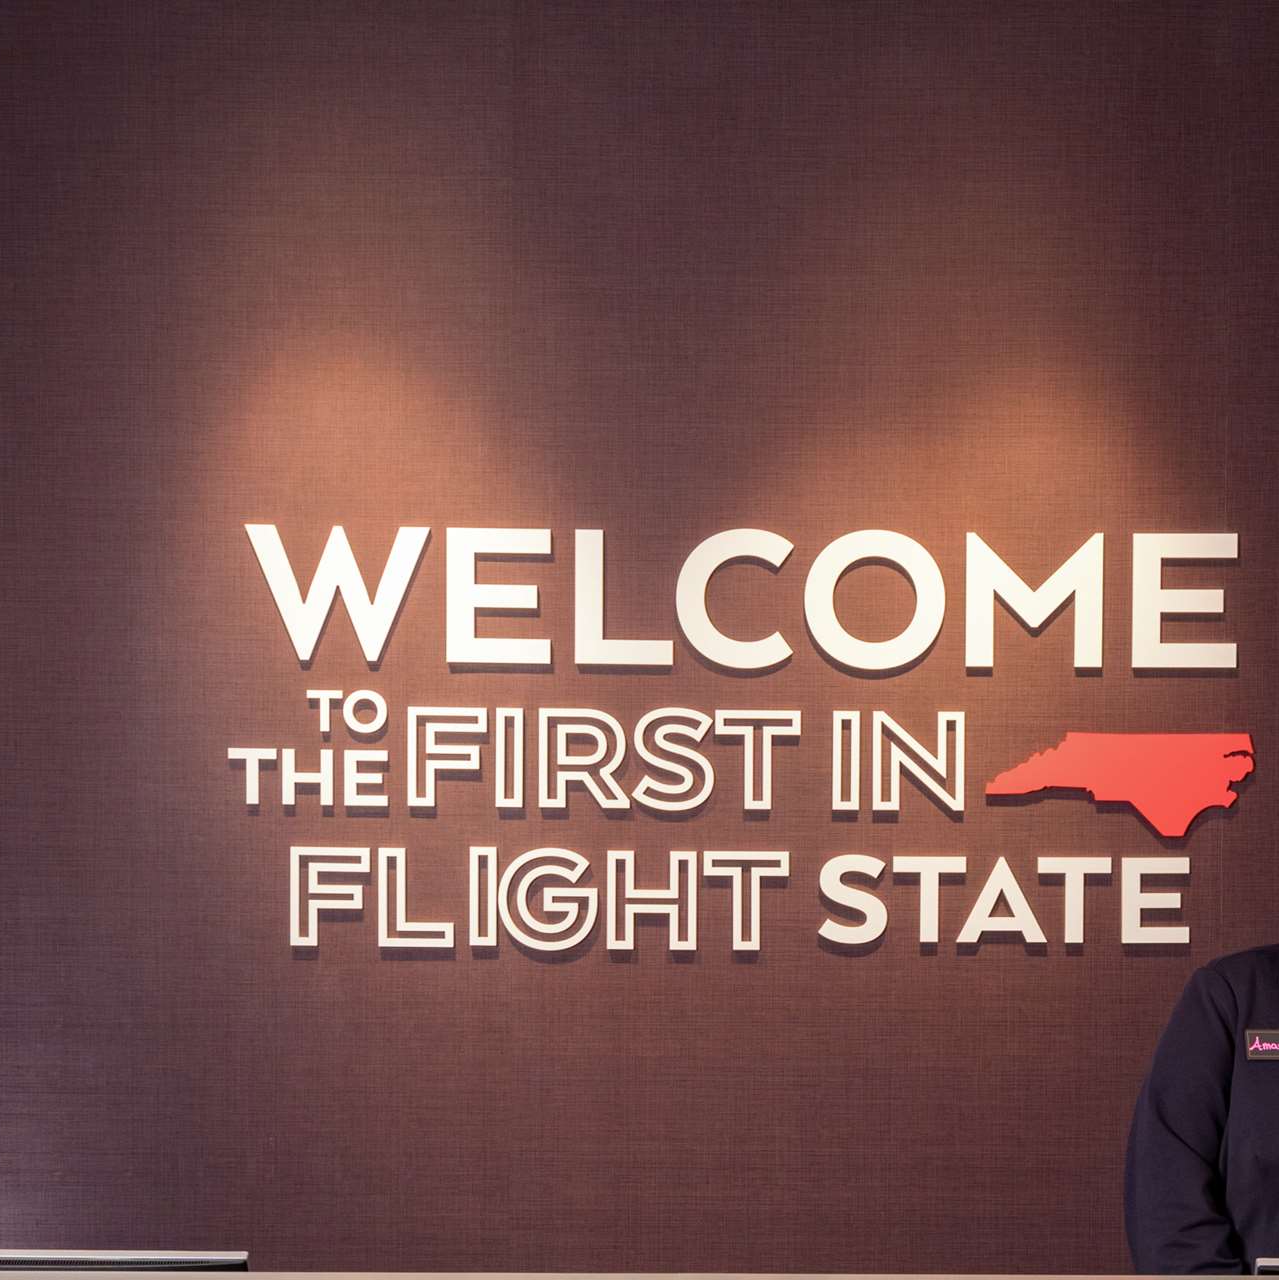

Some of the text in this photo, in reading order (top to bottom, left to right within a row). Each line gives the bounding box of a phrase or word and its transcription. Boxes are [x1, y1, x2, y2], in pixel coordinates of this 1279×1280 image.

[244, 524, 1239, 672] WELCOME
[227, 706, 966, 812] THE FIRST IN
[305, 689, 388, 736] TO
[289, 845, 1191, 953] FLIGHT STATE
